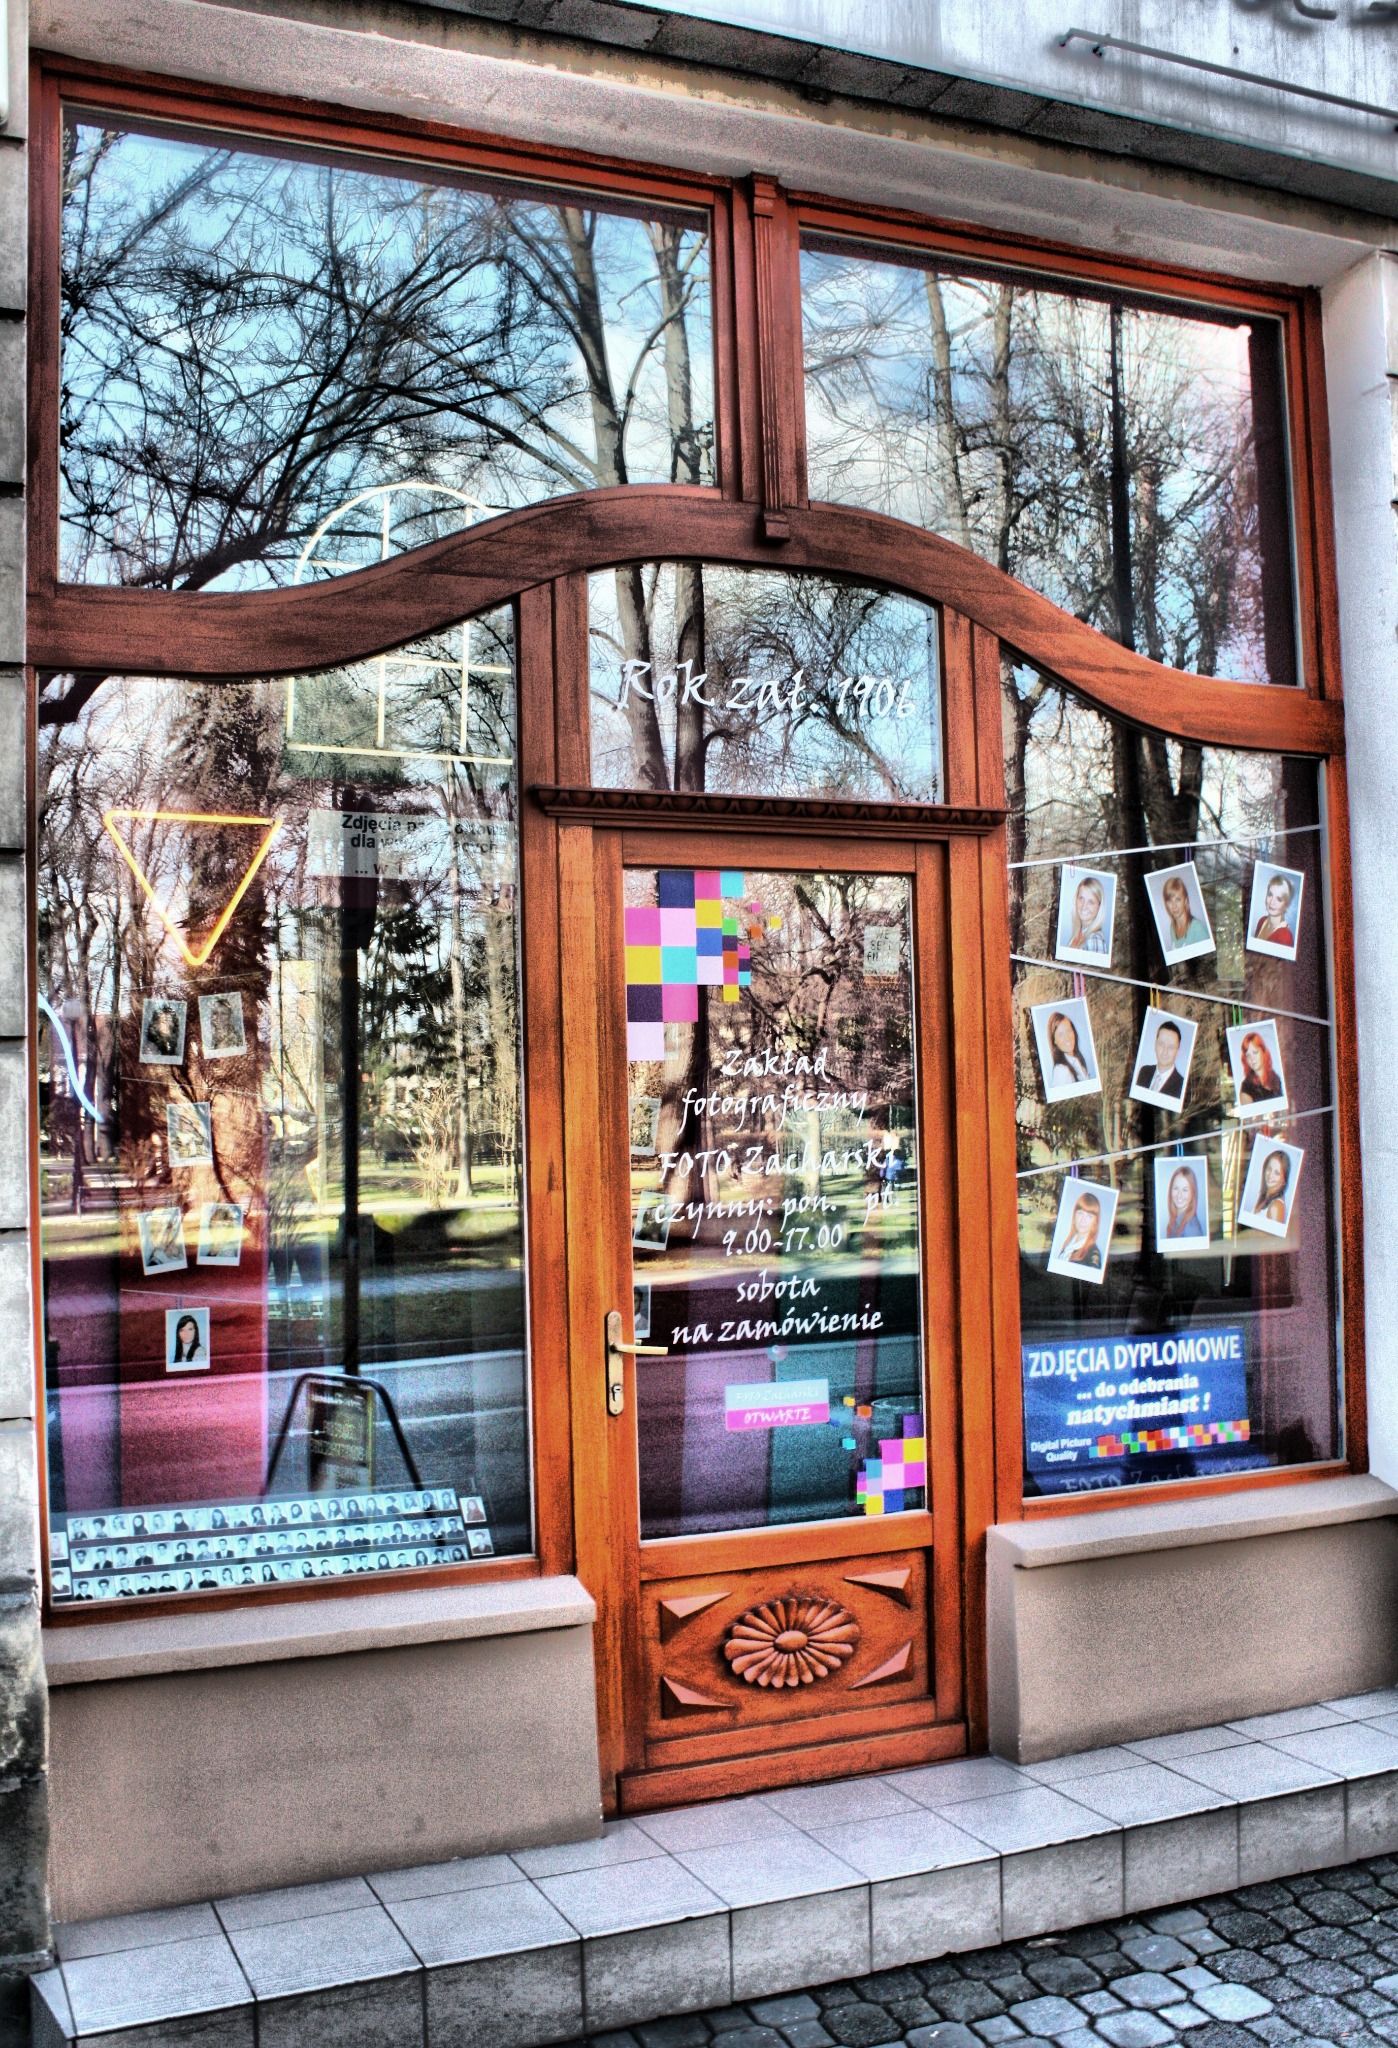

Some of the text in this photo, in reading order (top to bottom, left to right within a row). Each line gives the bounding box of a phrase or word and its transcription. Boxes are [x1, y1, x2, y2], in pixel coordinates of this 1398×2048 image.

[616, 658, 916, 718] Rok zał. 1906
[341, 814, 400, 834] Zdjęcia
[351, 834, 375, 849] dla
[721, 1047, 830, 1083] Zakład
[677, 1084, 867, 1135] fotograficzny
[659, 1139, 898, 1182] FOTO Zacharski
[654, 1196, 774, 1239] czynny:
[781, 1193, 837, 1231] pon.
[737, 1268, 820, 1303] sobota
[671, 1303, 884, 1345] na zamówienie
[1028, 1334, 1242, 1382] ZDJĘCIA DYPLOMOWE
[1095, 1382, 1117, 1398] do
[1118, 1373, 1200, 1395] odebrania
[744, 1407, 812, 1424] OTWARTE
[1066, 1394, 1200, 1426] natychmiast
[1031, 1437, 1092, 1453] Digital Picture
[1046, 1449, 1078, 1463] Quality
